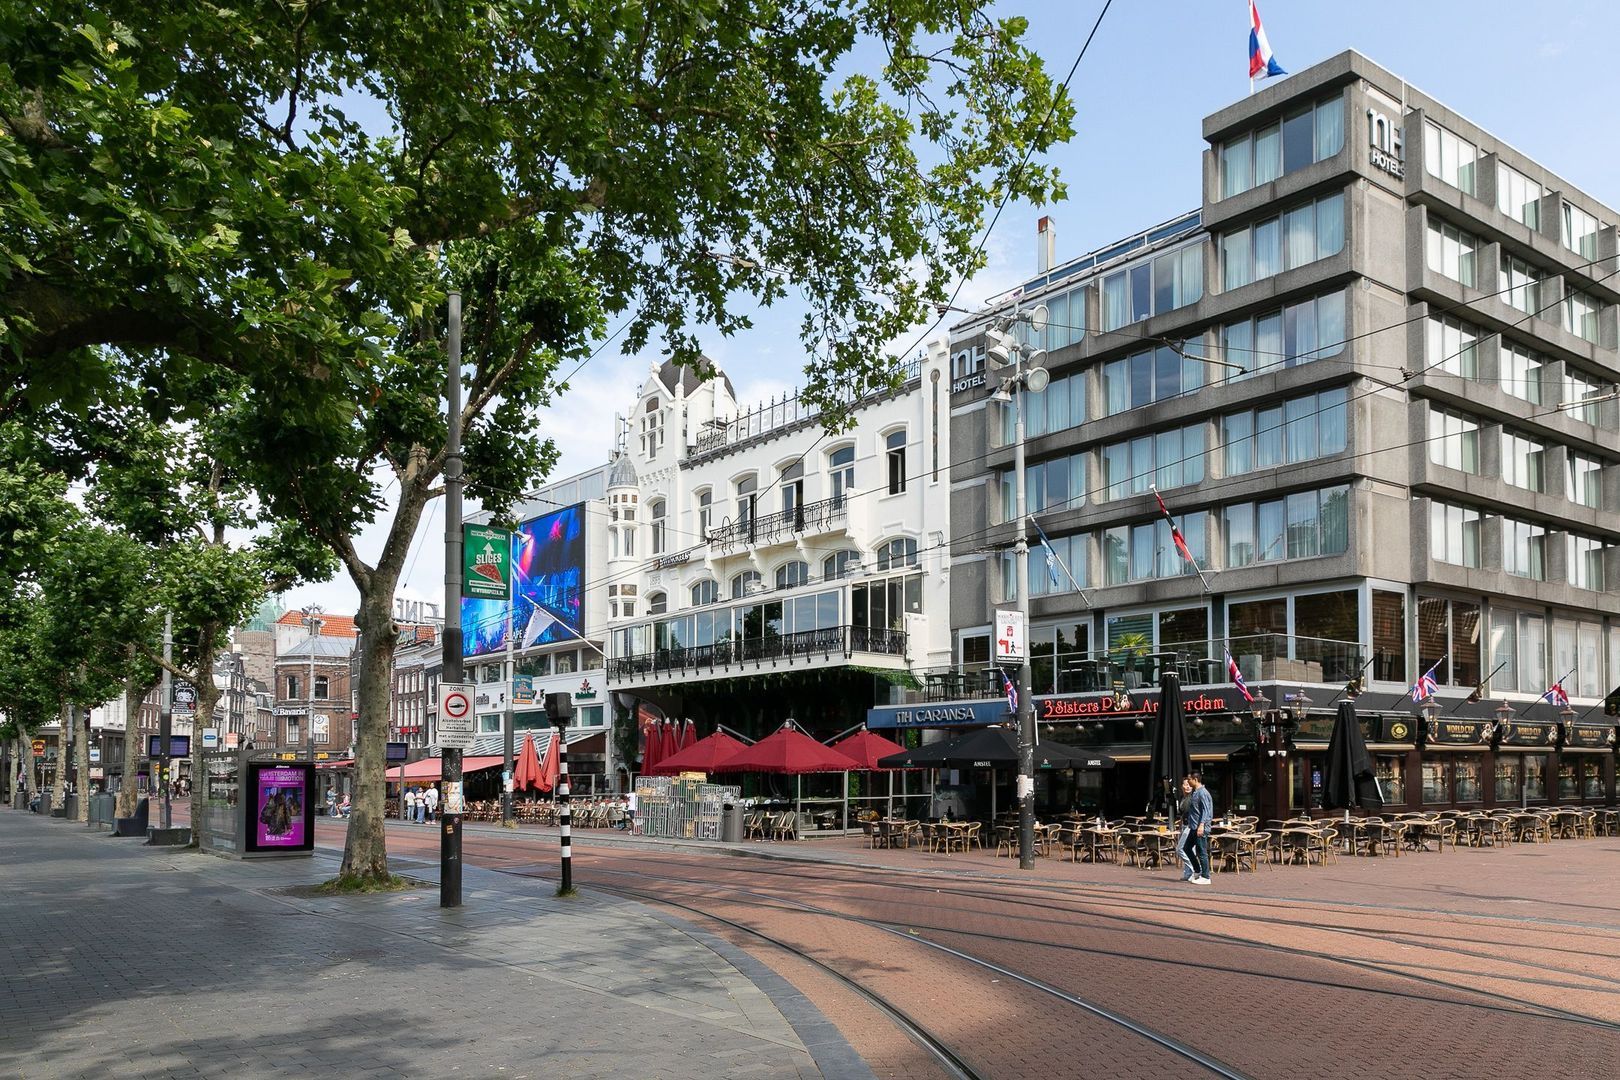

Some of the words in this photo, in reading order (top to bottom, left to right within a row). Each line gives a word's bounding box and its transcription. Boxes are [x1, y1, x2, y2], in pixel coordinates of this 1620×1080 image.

[1371, 150, 1405, 178] HOTELS
[953, 374, 986, 393] HOTELS
[476, 553, 502, 564] SLICES
[915, 708, 975, 722] CARANSA
[1044, 700, 1053, 717] 3
[1055, 701, 1099, 714] Sisters
[1446, 725, 1464, 734] WORLD
[1465, 725, 1475, 734] CUP
